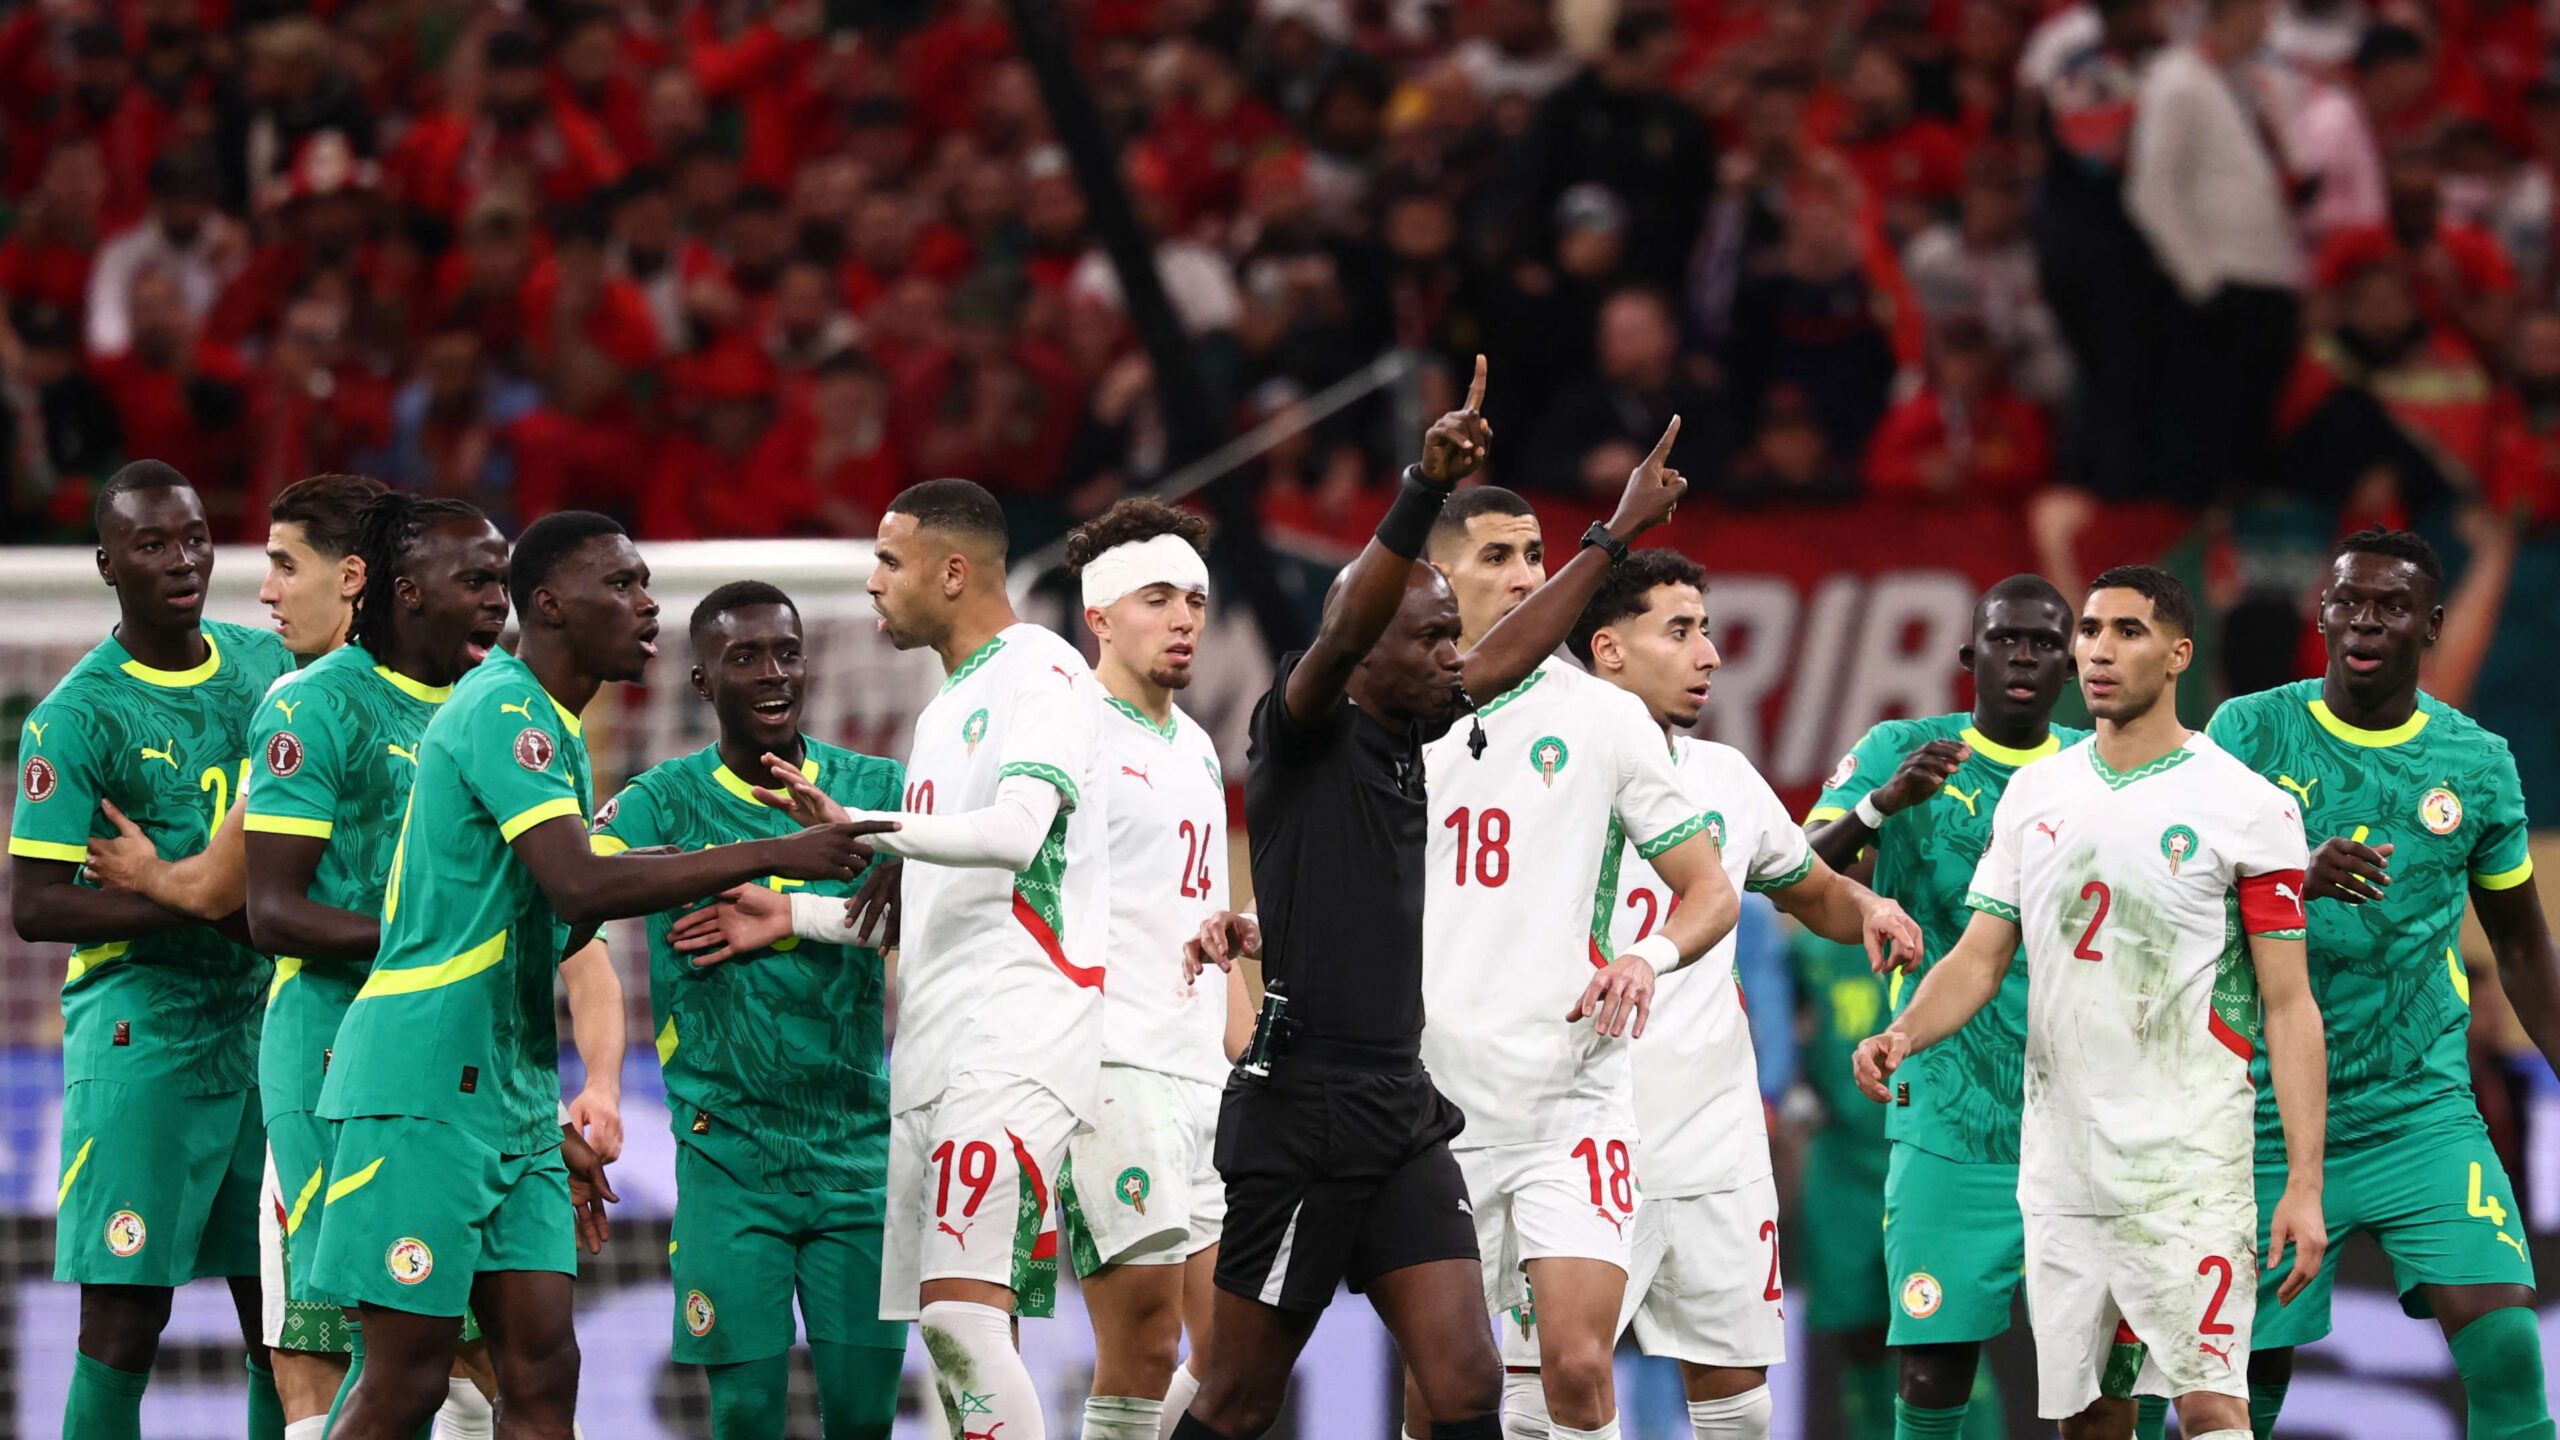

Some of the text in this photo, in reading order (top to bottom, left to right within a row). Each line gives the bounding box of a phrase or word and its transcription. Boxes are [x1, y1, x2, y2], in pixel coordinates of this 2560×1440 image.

[1179, 820, 1211, 901] 24
[1445, 807, 1510, 888] 18
[2074, 881, 2111, 961] 2
[932, 1140, 997, 1218] 19
[1571, 1138, 1633, 1213] 18
[2467, 1162, 2507, 1226] 4
[2198, 1256, 2234, 1334] 2
